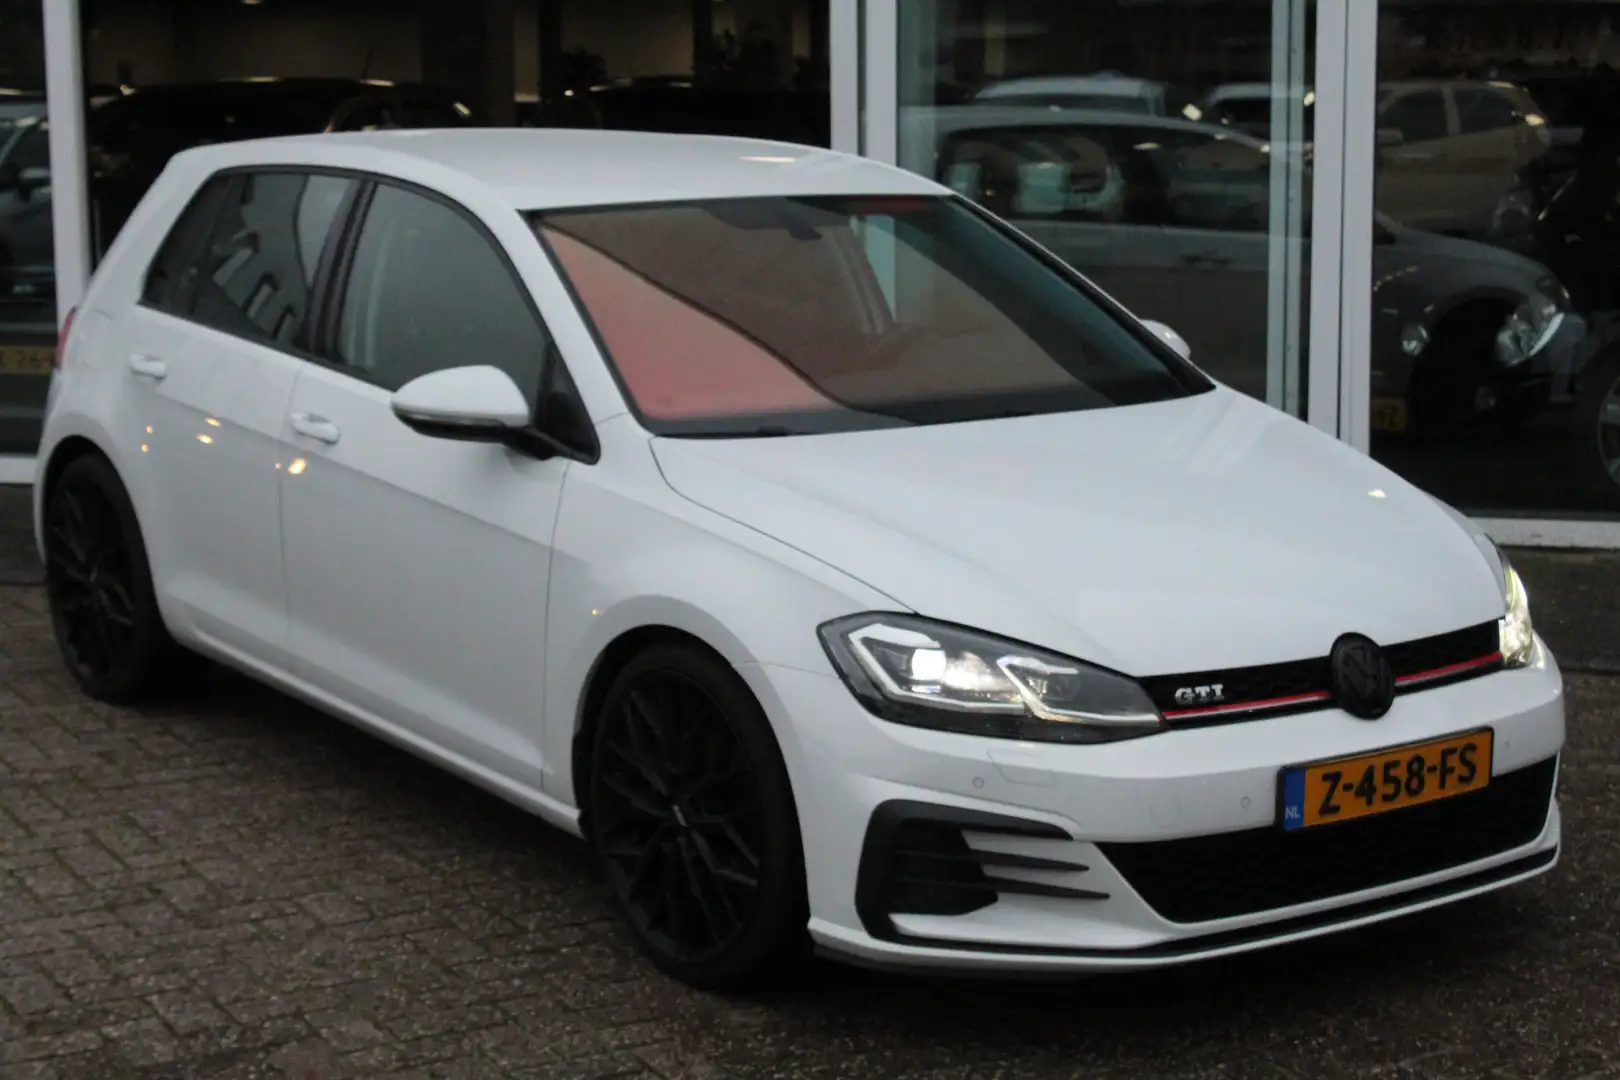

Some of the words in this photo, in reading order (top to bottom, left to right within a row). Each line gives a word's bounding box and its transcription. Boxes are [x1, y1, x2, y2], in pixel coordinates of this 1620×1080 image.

[1175, 684, 1224, 705] GTI
[1318, 742, 1477, 817] Z-458-FS
[1285, 806, 1300, 820] NL
